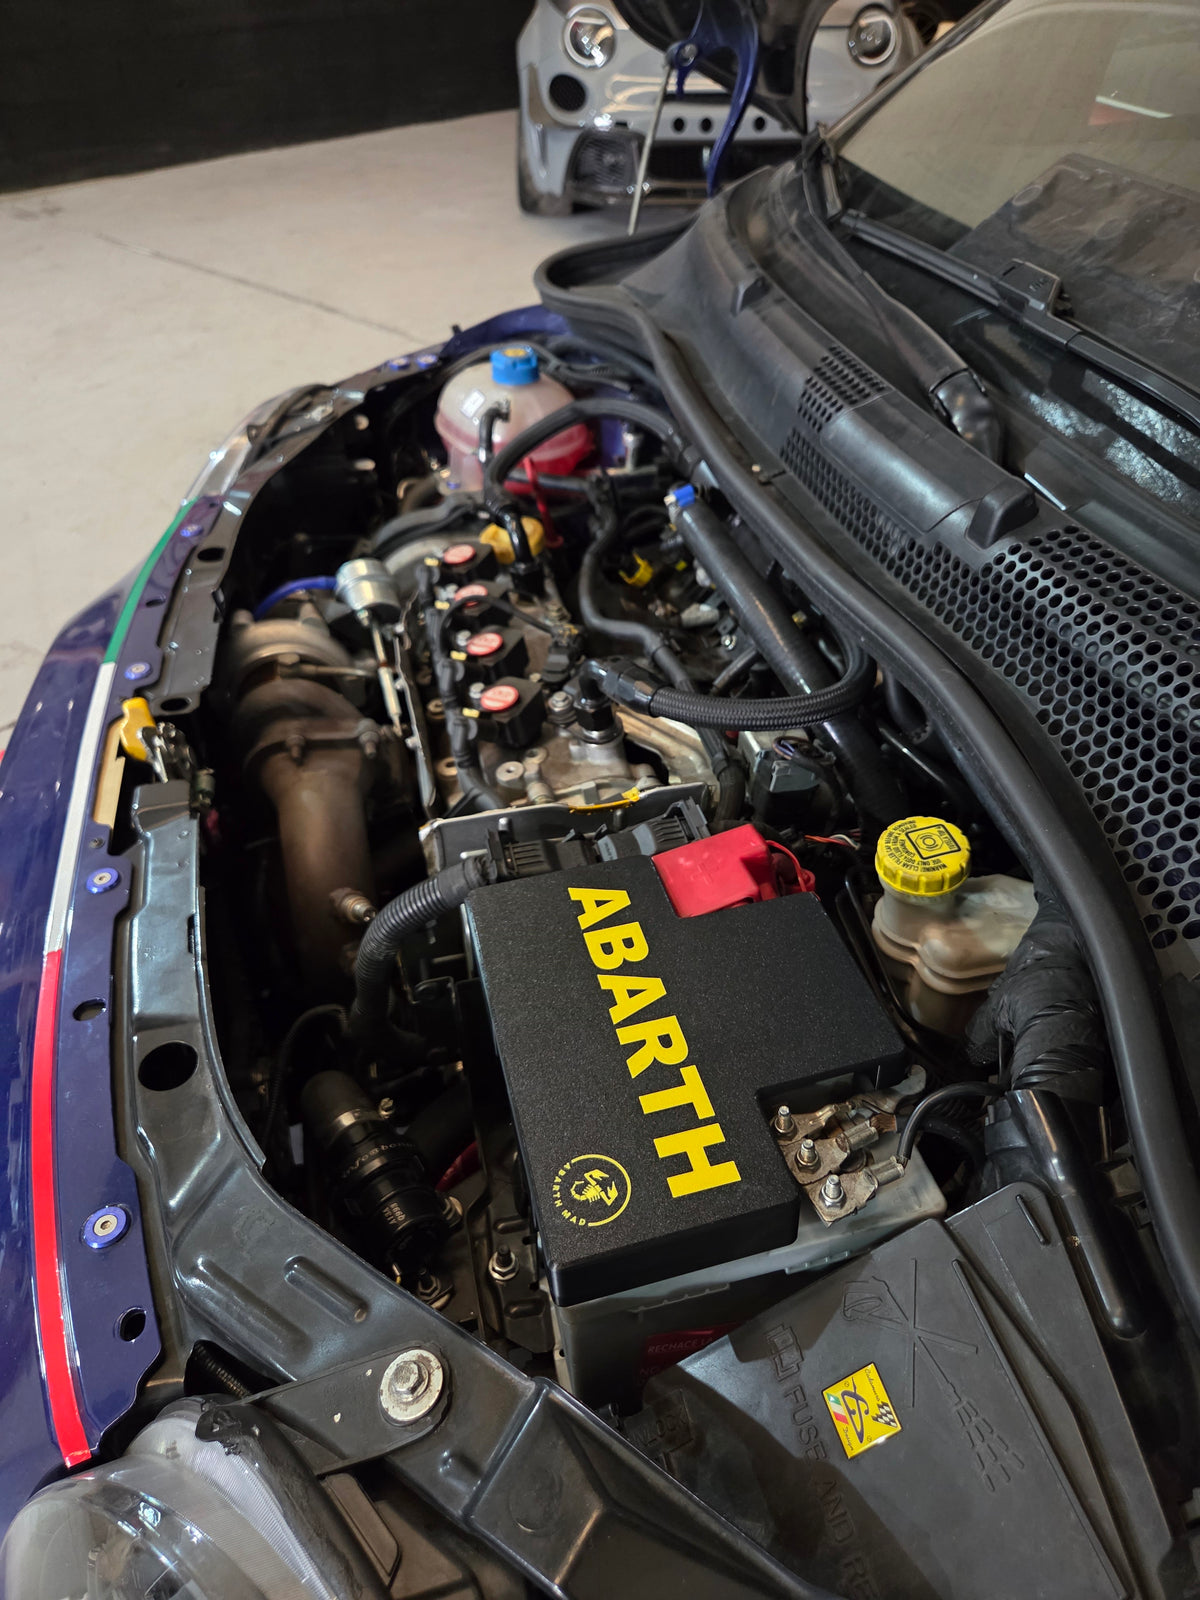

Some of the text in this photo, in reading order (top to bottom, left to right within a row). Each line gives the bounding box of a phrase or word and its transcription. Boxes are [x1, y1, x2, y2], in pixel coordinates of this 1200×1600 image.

[568, 887, 741, 1198] ABARTH
[553, 1162, 586, 1226] ABARTH MAD
[783, 1385, 827, 1461] FUSE
[815, 1479, 856, 1544] AND
